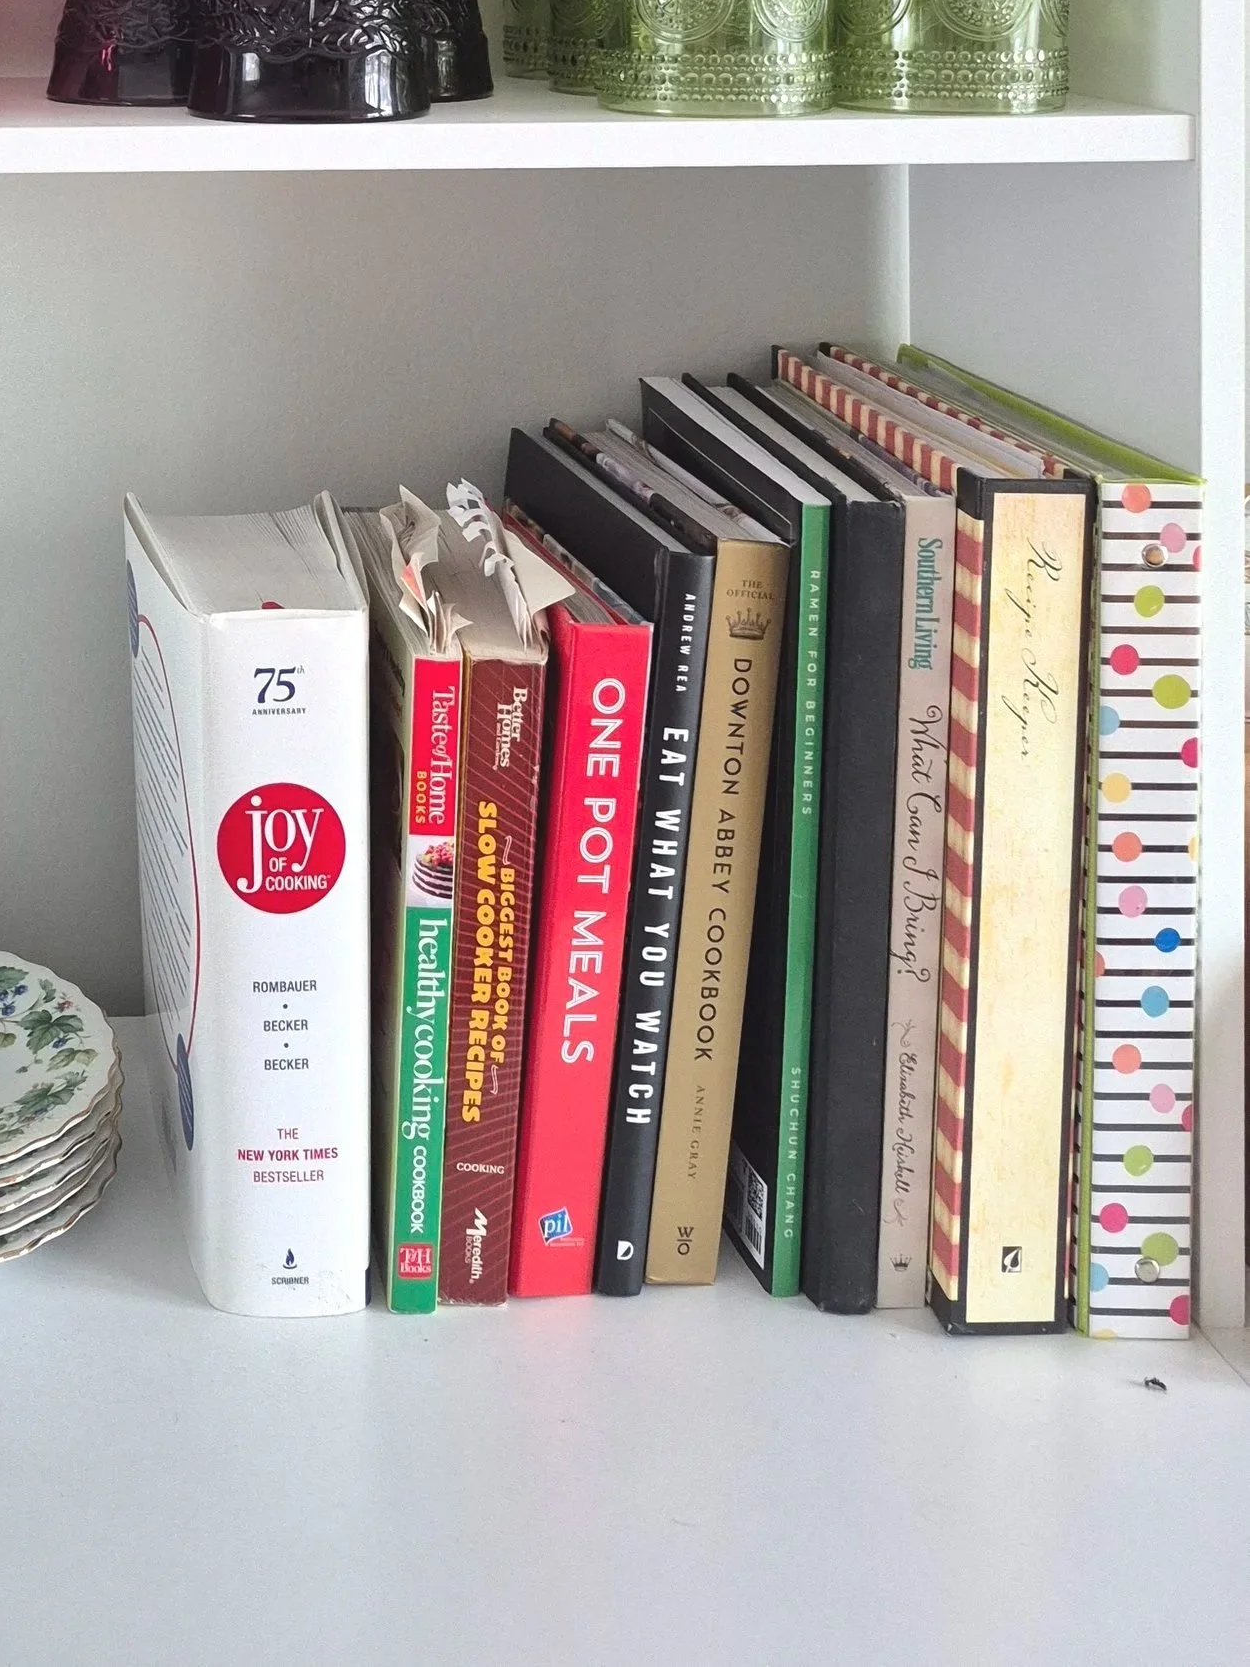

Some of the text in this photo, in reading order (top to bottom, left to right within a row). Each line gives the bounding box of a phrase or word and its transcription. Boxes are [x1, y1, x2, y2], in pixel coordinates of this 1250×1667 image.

[726, 588, 774, 600] OFFICIAL
[742, 579, 763, 589] THE
[908, 537, 943, 670] Southern Living
[676, 593, 697, 693] ANDREW REA
[1001, 537, 1063, 758] Recipe Keeper
[252, 707, 307, 716] ANNIVERSARY
[511, 686, 528, 742] Better
[802, 570, 821, 815] RAMEN FOR BEGINNERS
[496, 702, 514, 768] Homes
[415, 771, 428, 824] BOOKS
[236, 794, 324, 894] joy
[268, 857, 287, 872] OF
[560, 677, 626, 1065] ONE POT MEALS
[694, 658, 753, 1061] DOWNTON ABBEY COOKBOOK
[889, 704, 949, 983] What Can I Bring?
[265, 875, 327, 891] COOKING
[626, 726, 689, 1124] EAT WHAT YOU WATCH
[253, 980, 317, 993] ROMBAUER
[461, 801, 498, 1123] SLOW COOKER RECIPES
[490, 867, 516, 1064] BIGGEST BOOK OF
[263, 1019, 308, 1032] BECKER
[264, 1058, 309, 1071] BECKER
[899, 1051, 917, 1124] Elizabeth
[238, 1147, 338, 1161] NEW YORK TIMES
[277, 1128, 299, 1140] THE
[687, 1085, 706, 1179] ANNIE GRAY
[784, 1067, 801, 1238] SHUCHUN CHANG
[253, 1170, 324, 1183] BESTSELLER
[410, 1145, 427, 1234] COOKBOOK
[456, 1162, 505, 1175] COOKING
[465, 1207, 488, 1280] Meredith
[544, 1213, 568, 1238] pil
[271, 1277, 310, 1285] SCRIBNER
